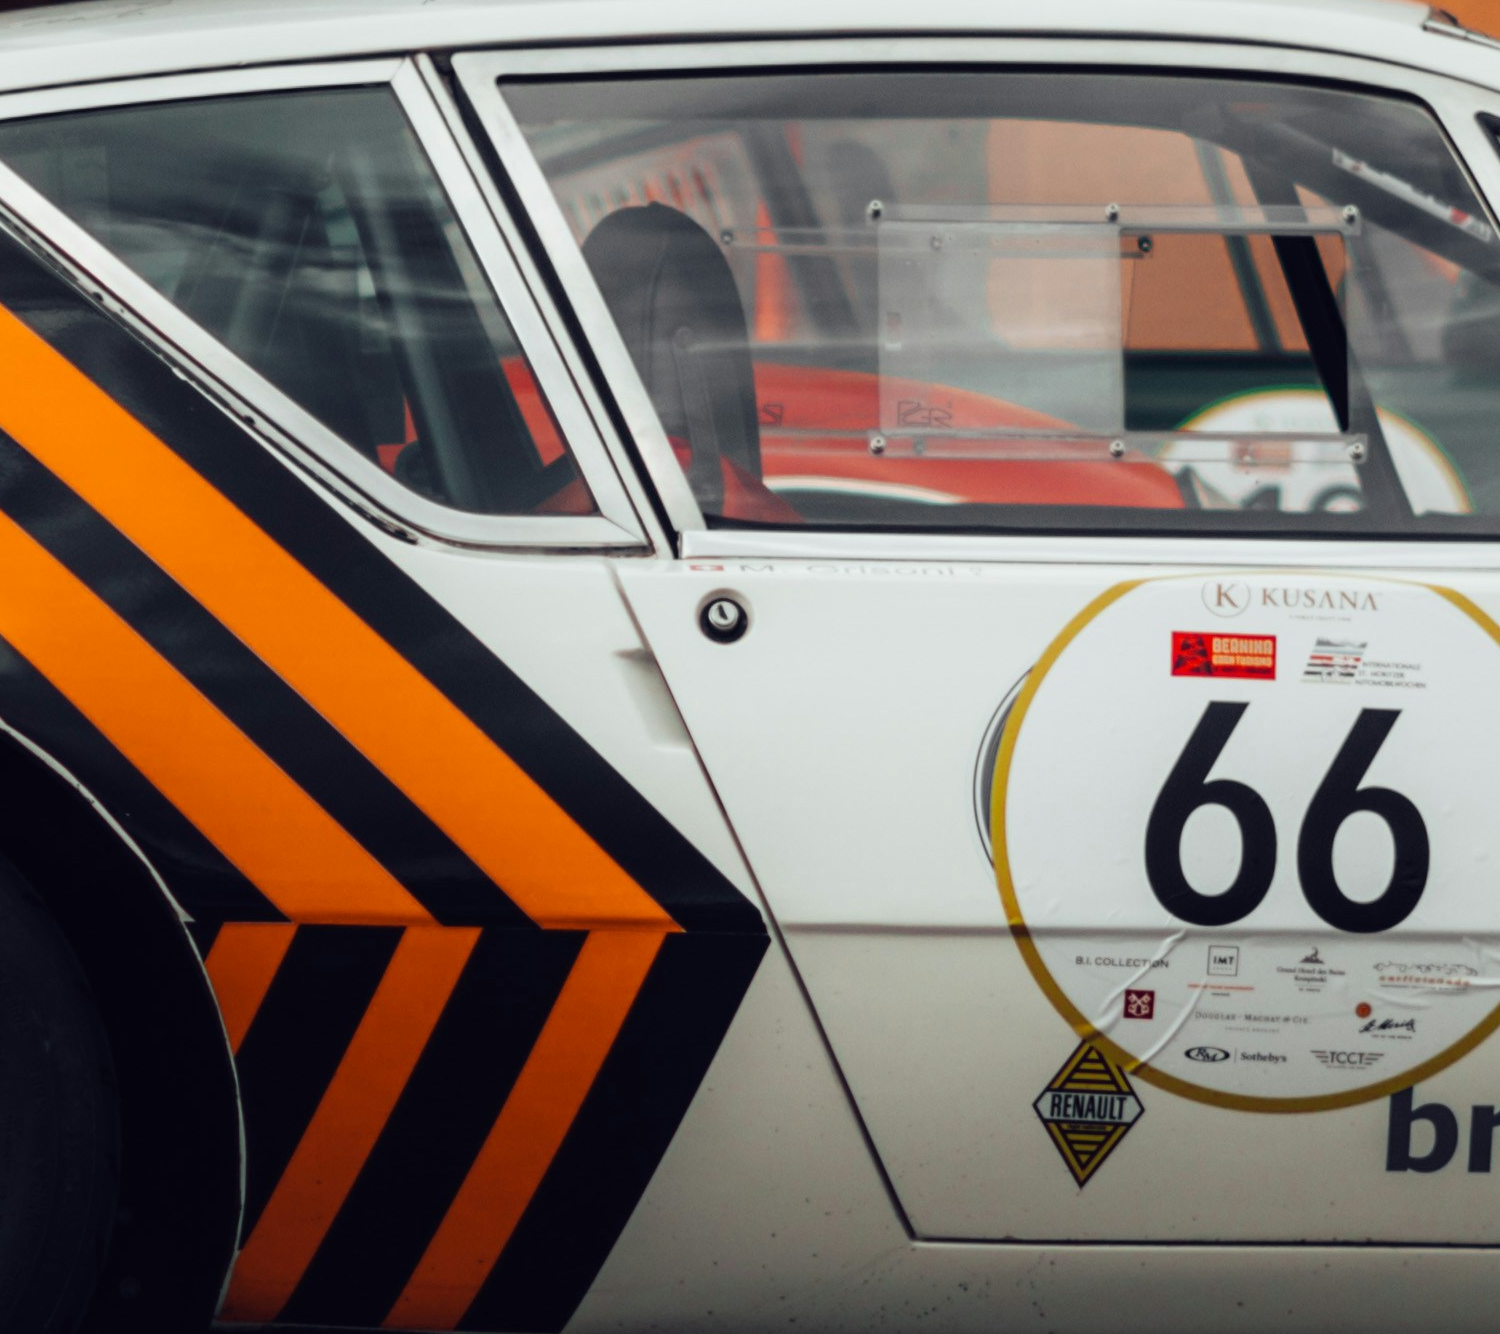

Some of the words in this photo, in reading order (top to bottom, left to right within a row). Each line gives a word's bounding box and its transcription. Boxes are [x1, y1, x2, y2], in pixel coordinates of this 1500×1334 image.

[1261, 587, 1379, 612] KUSANA
[1212, 637, 1273, 655] BERNINA
[1144, 700, 1430, 934] 66
[1095, 956, 1170, 968] COLLECTON
[1213, 956, 1235, 966] IMT
[1240, 1051, 1287, 1063] Sotheby's
[1050, 1093, 1128, 1121] RENAULT
